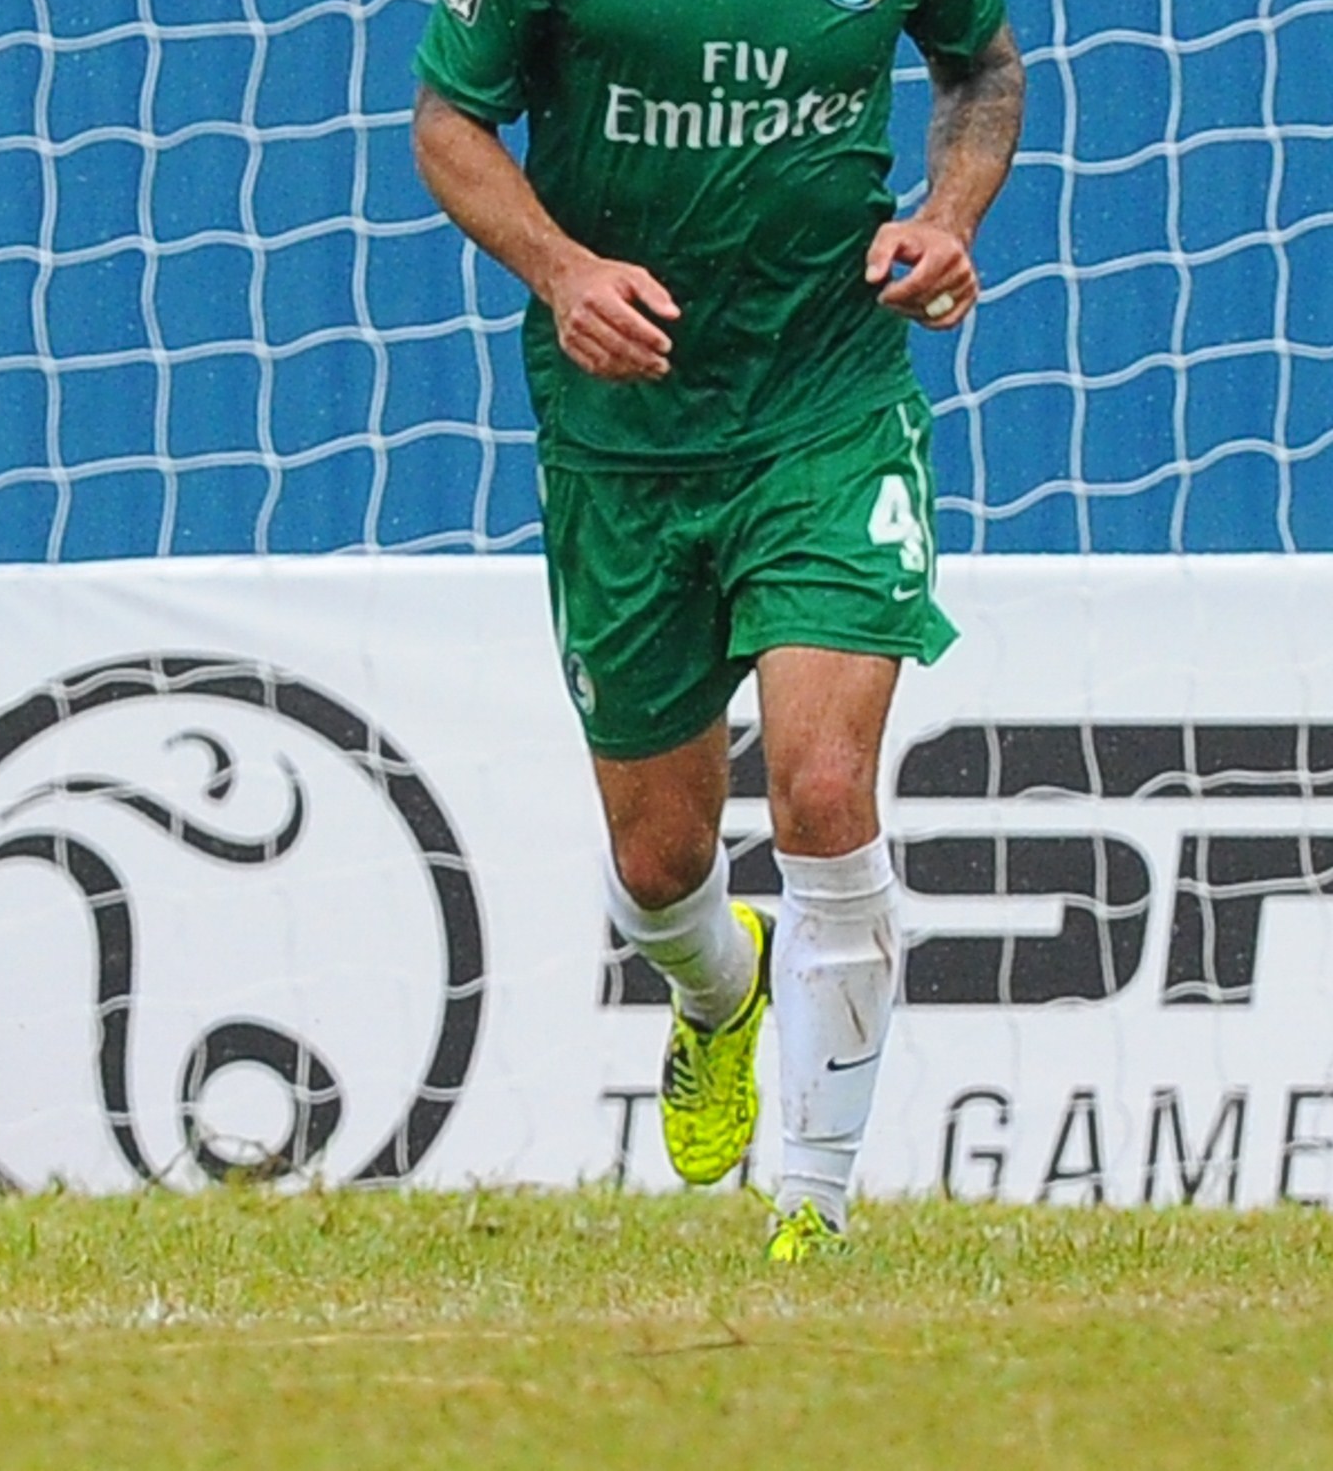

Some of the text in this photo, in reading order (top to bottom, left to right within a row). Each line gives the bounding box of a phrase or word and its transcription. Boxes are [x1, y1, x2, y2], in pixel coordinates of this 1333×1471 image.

[702, 40, 789, 90] Fly
[603, 82, 868, 150] Emirates
[867, 473, 926, 574] 4
